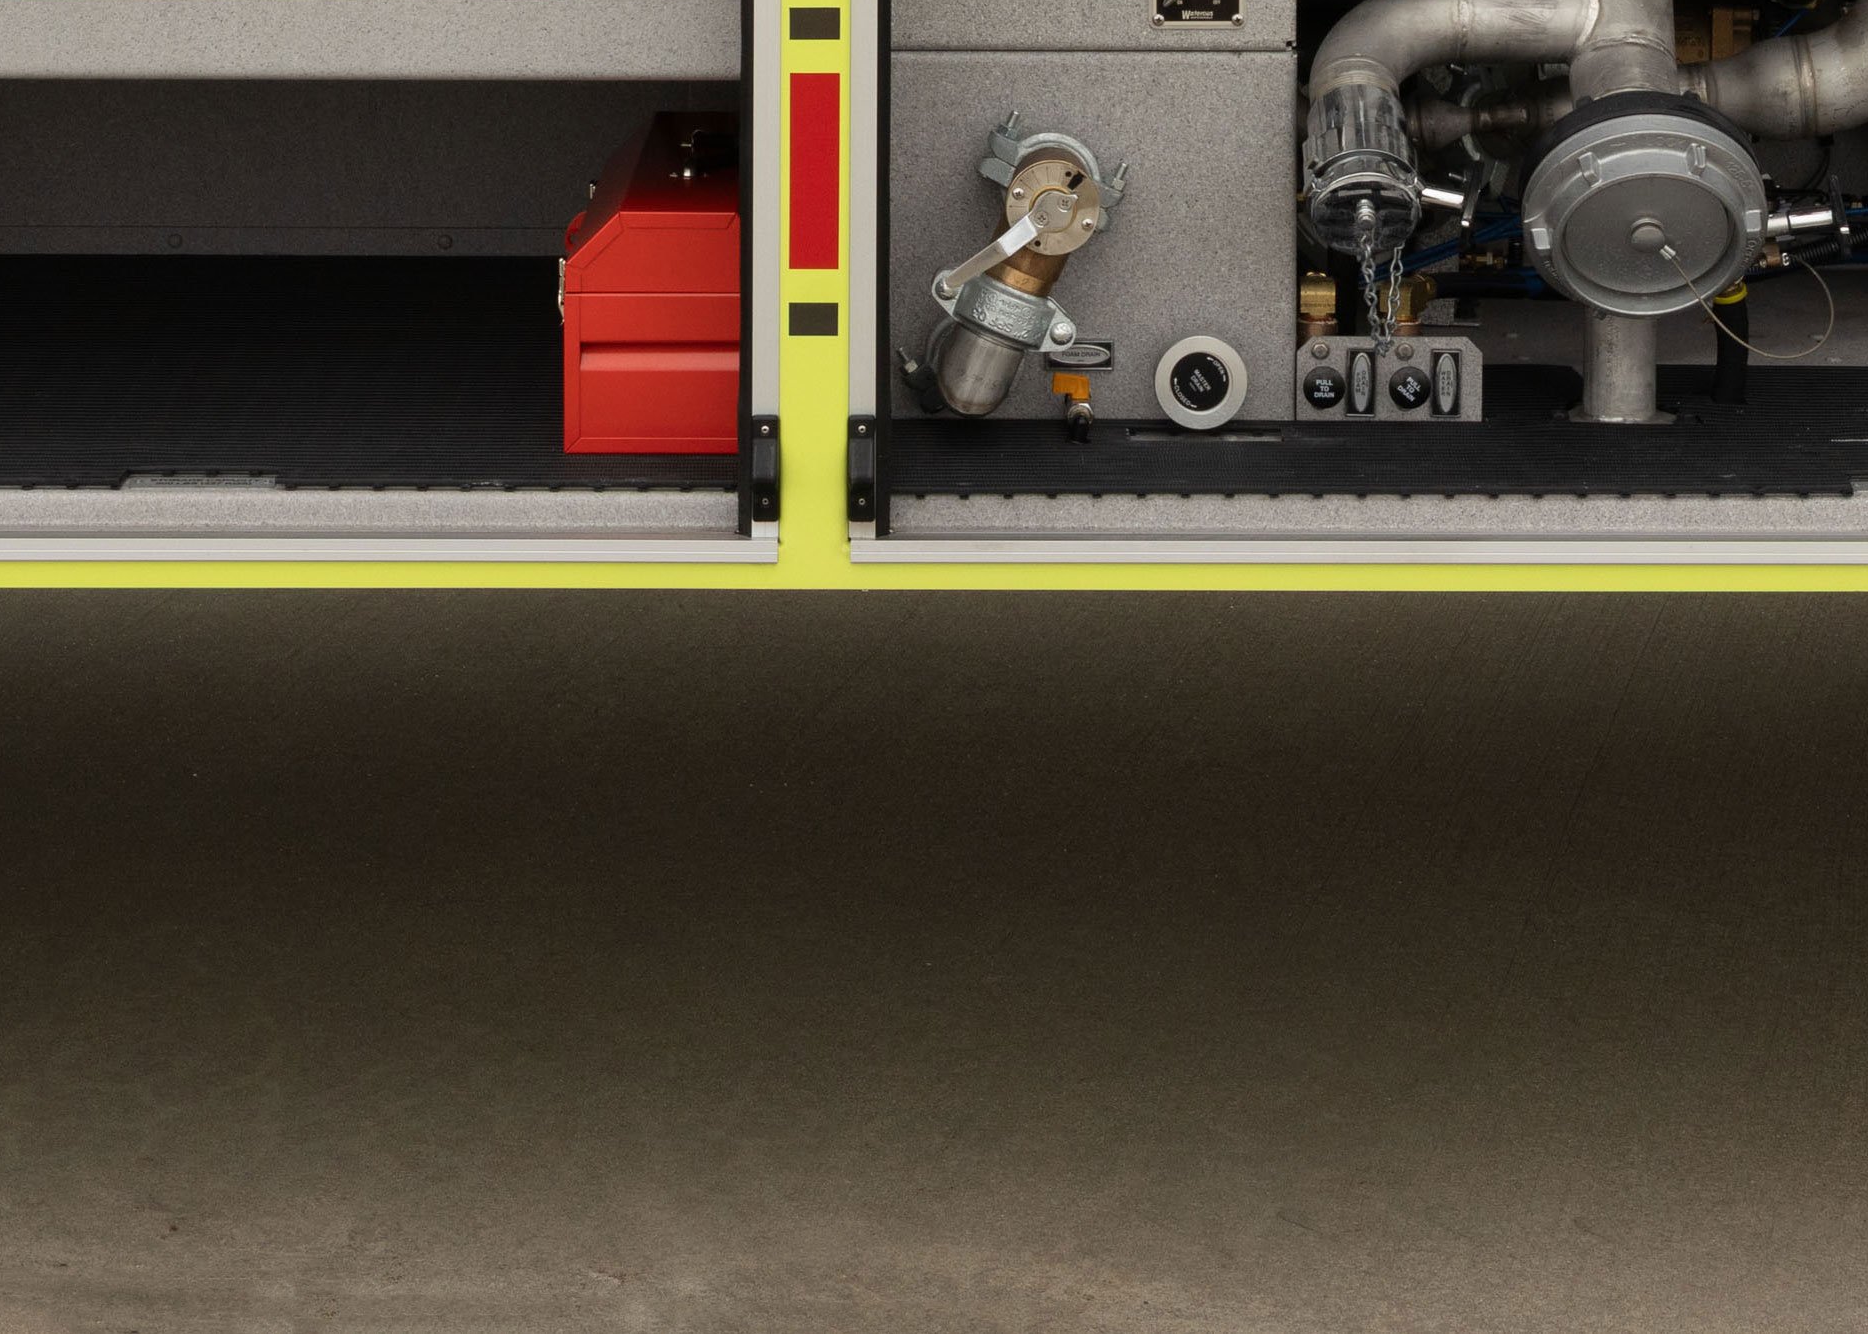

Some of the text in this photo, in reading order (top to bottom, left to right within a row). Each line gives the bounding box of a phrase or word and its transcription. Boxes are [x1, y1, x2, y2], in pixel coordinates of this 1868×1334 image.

[1212, 360, 1225, 375] OPEN
[1189, 375, 1205, 393] DRAIN
[1193, 368, 1212, 391] MASTER
[1405, 376, 1422, 393] PULL
[1173, 384, 1192, 407] CLOSED
[1313, 391, 1335, 399] DRAIN
[1396, 385, 1416, 403] DRAIN
[1405, 384, 1415, 394] TO
